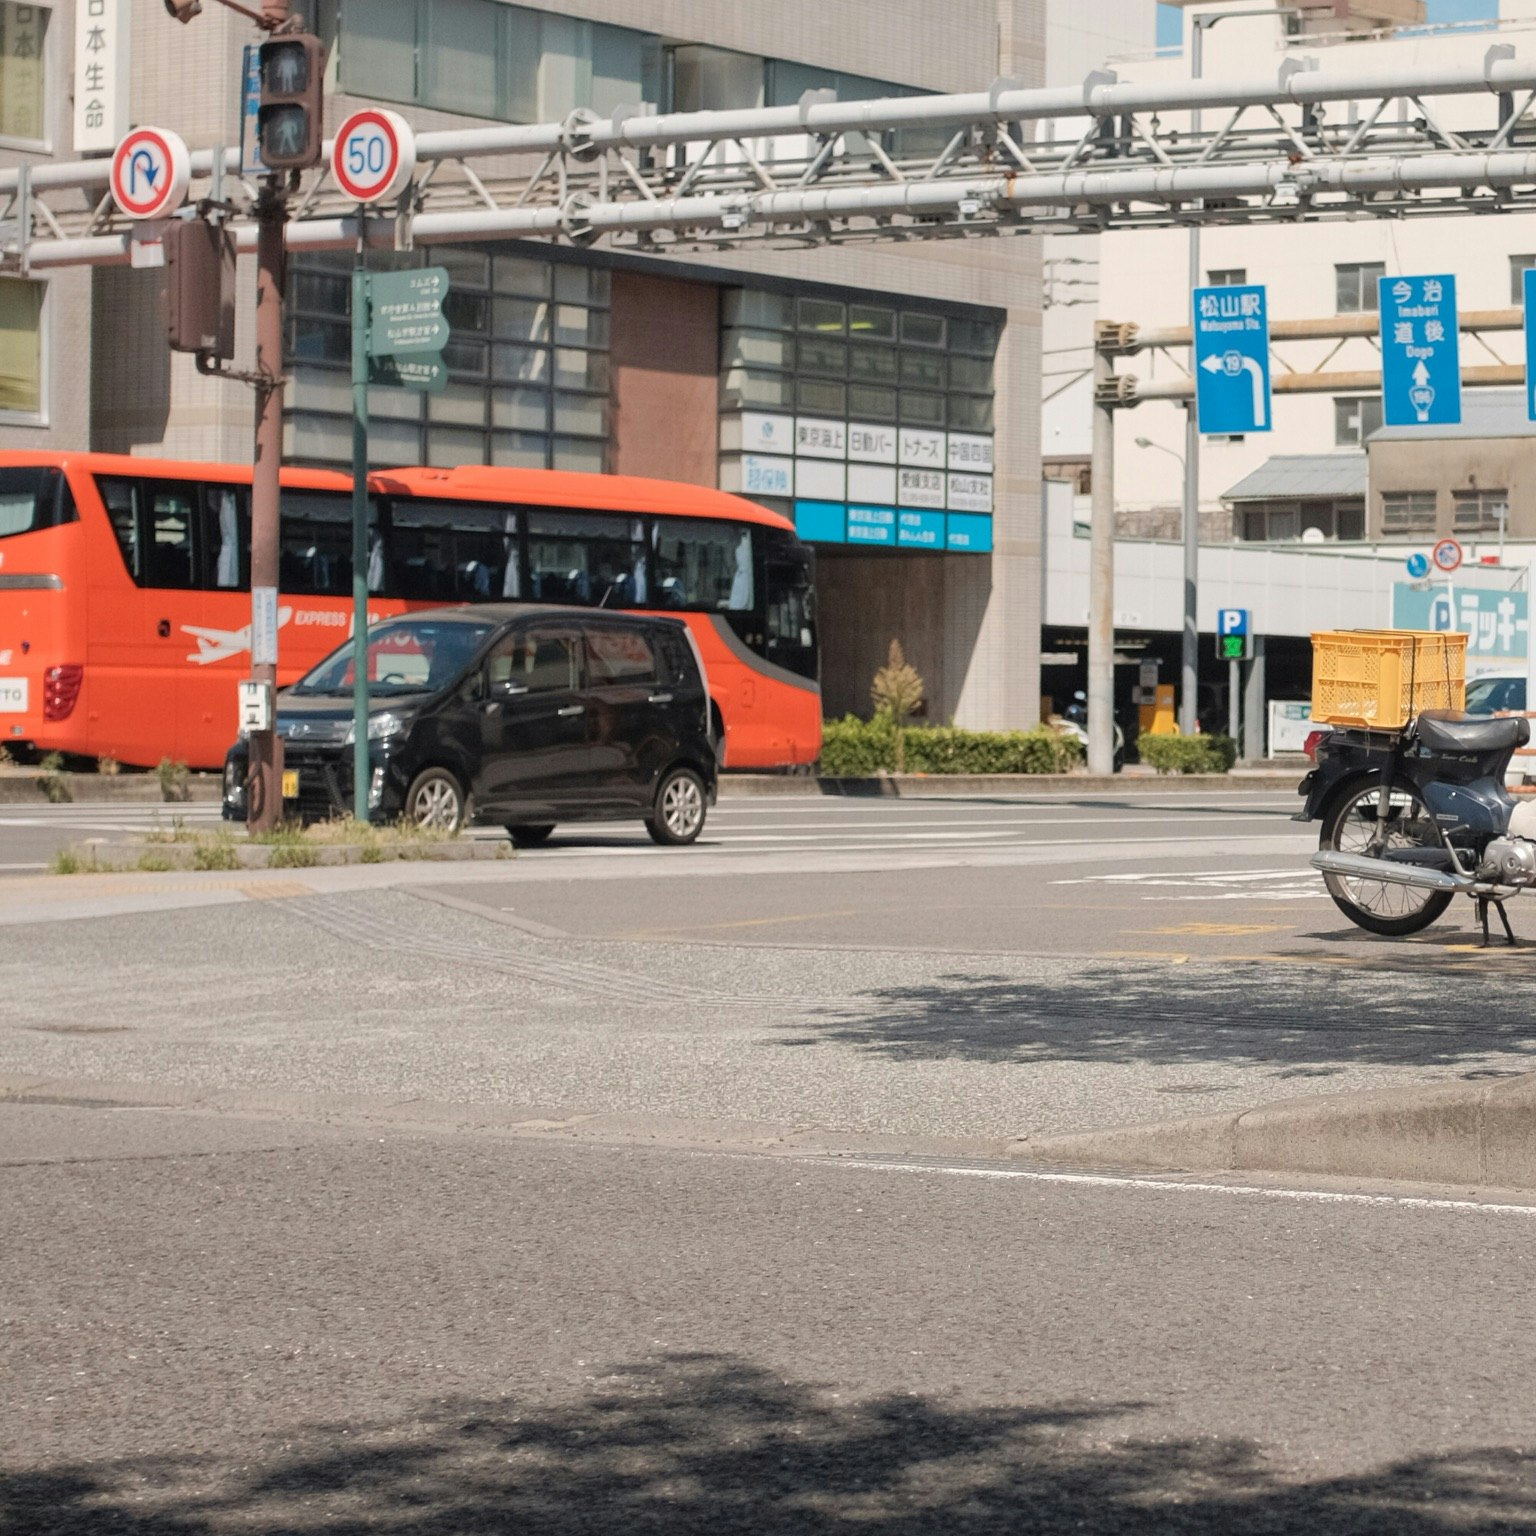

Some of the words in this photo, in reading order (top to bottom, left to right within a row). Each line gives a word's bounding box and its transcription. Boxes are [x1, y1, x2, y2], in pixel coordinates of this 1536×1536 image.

[350, 137, 384, 174] 50
[1392, 280, 1442, 303] 今治
[1200, 294, 1261, 317] 松山駅
[1398, 305, 1438, 317] Imabari
[1394, 320, 1444, 343] 道後
[1406, 345, 1433, 359] Dogo
[1226, 356, 1239, 371] 19
[295, 610, 346, 627] EXPRESS
[1223, 611, 1241, 633] P
